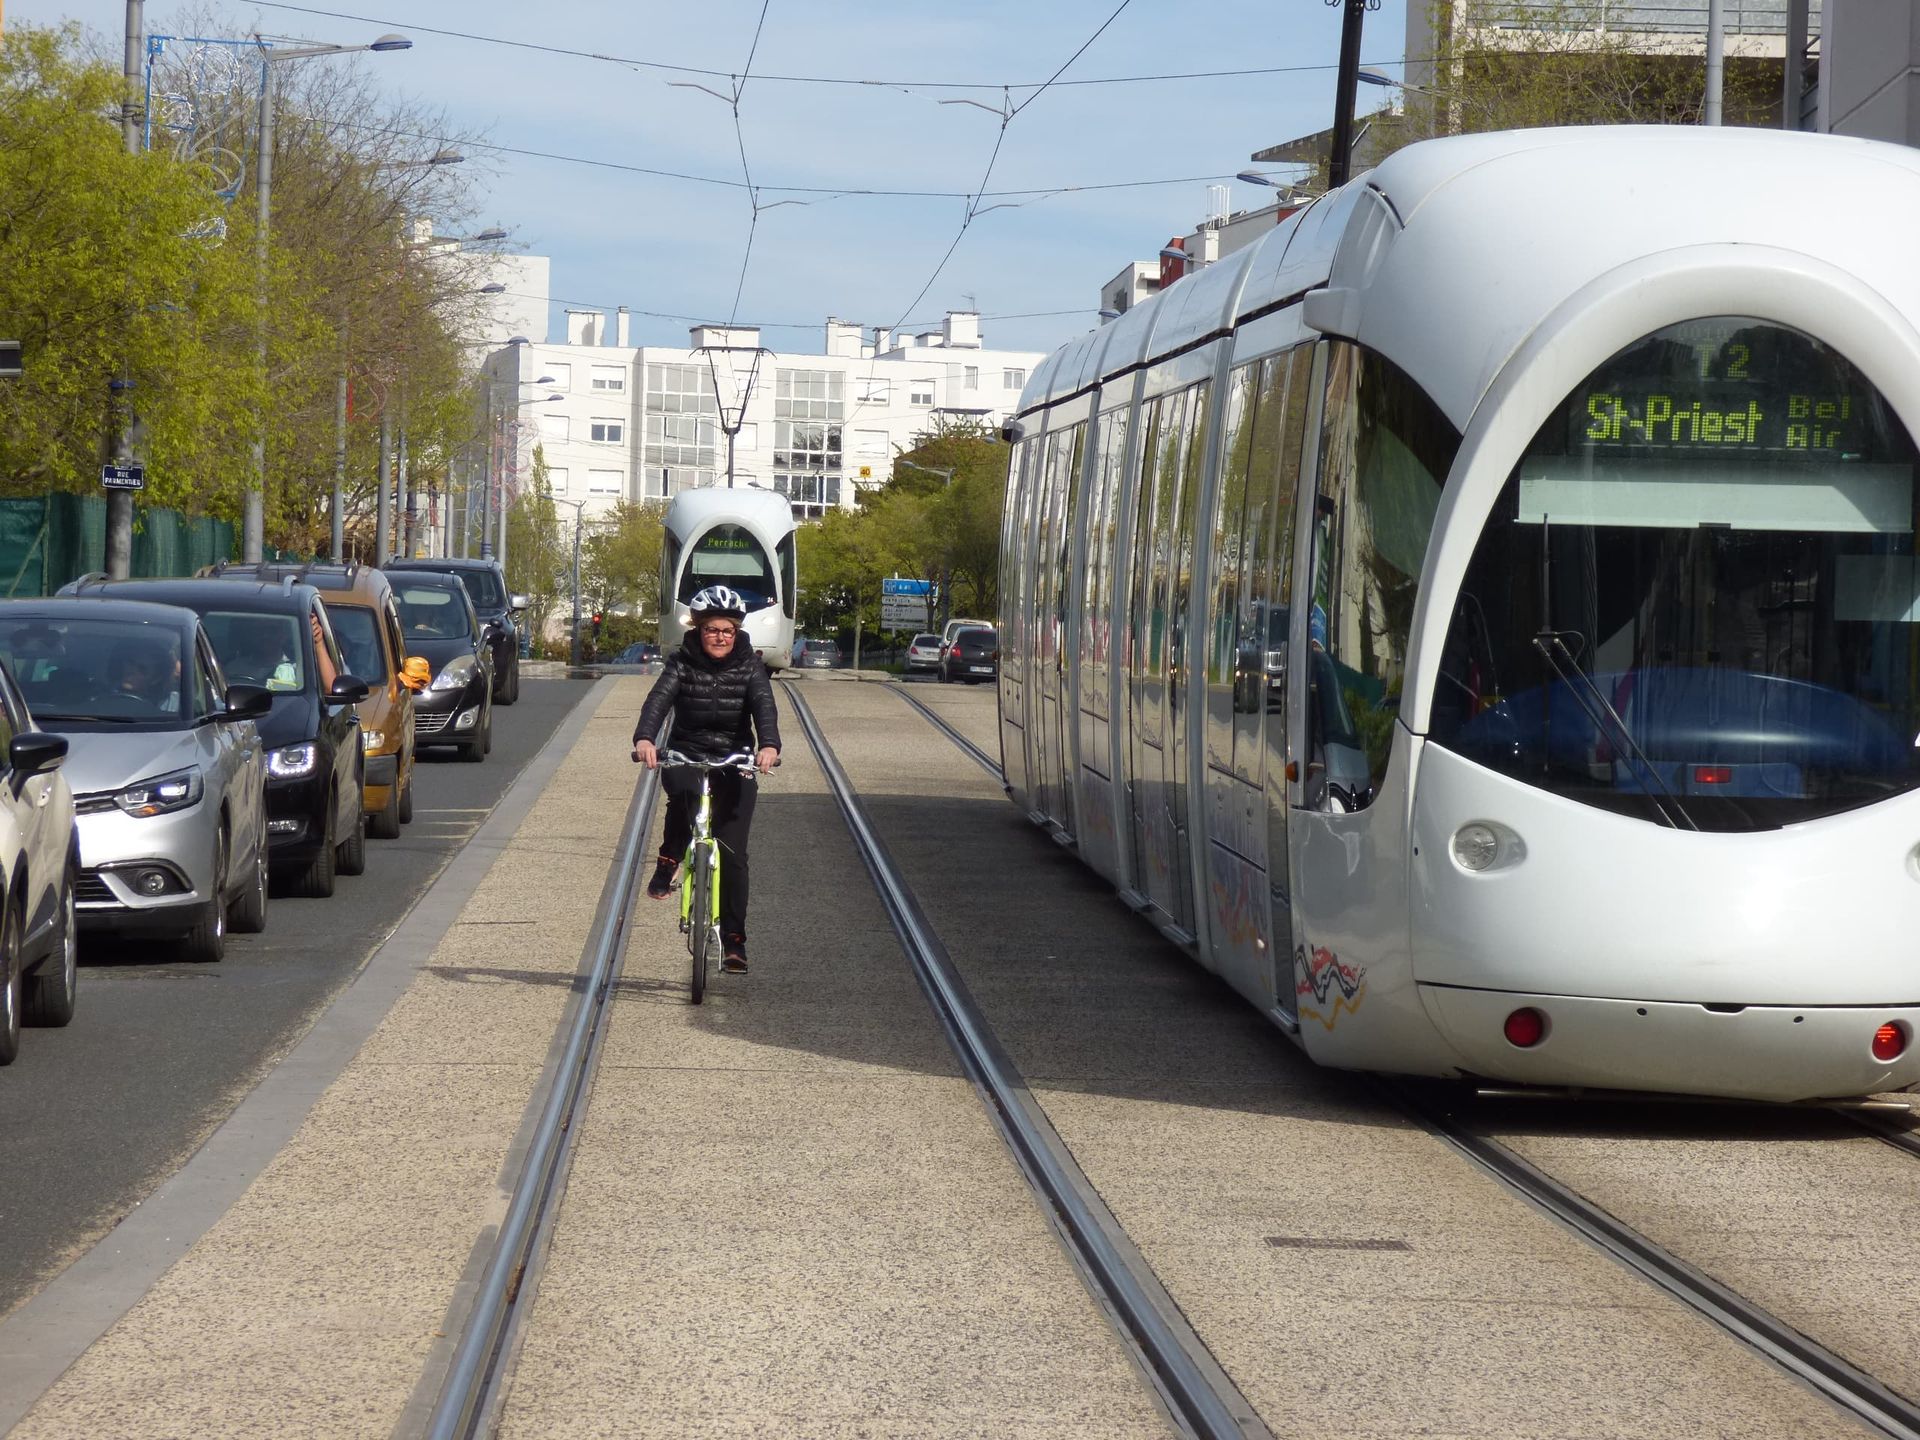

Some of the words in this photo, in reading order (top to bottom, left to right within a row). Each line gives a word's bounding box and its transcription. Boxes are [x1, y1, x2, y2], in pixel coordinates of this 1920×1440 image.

[1586, 393, 1762, 443] St-Priest
[1788, 394, 1850, 419] Bel
[1786, 424, 1841, 448] Air
